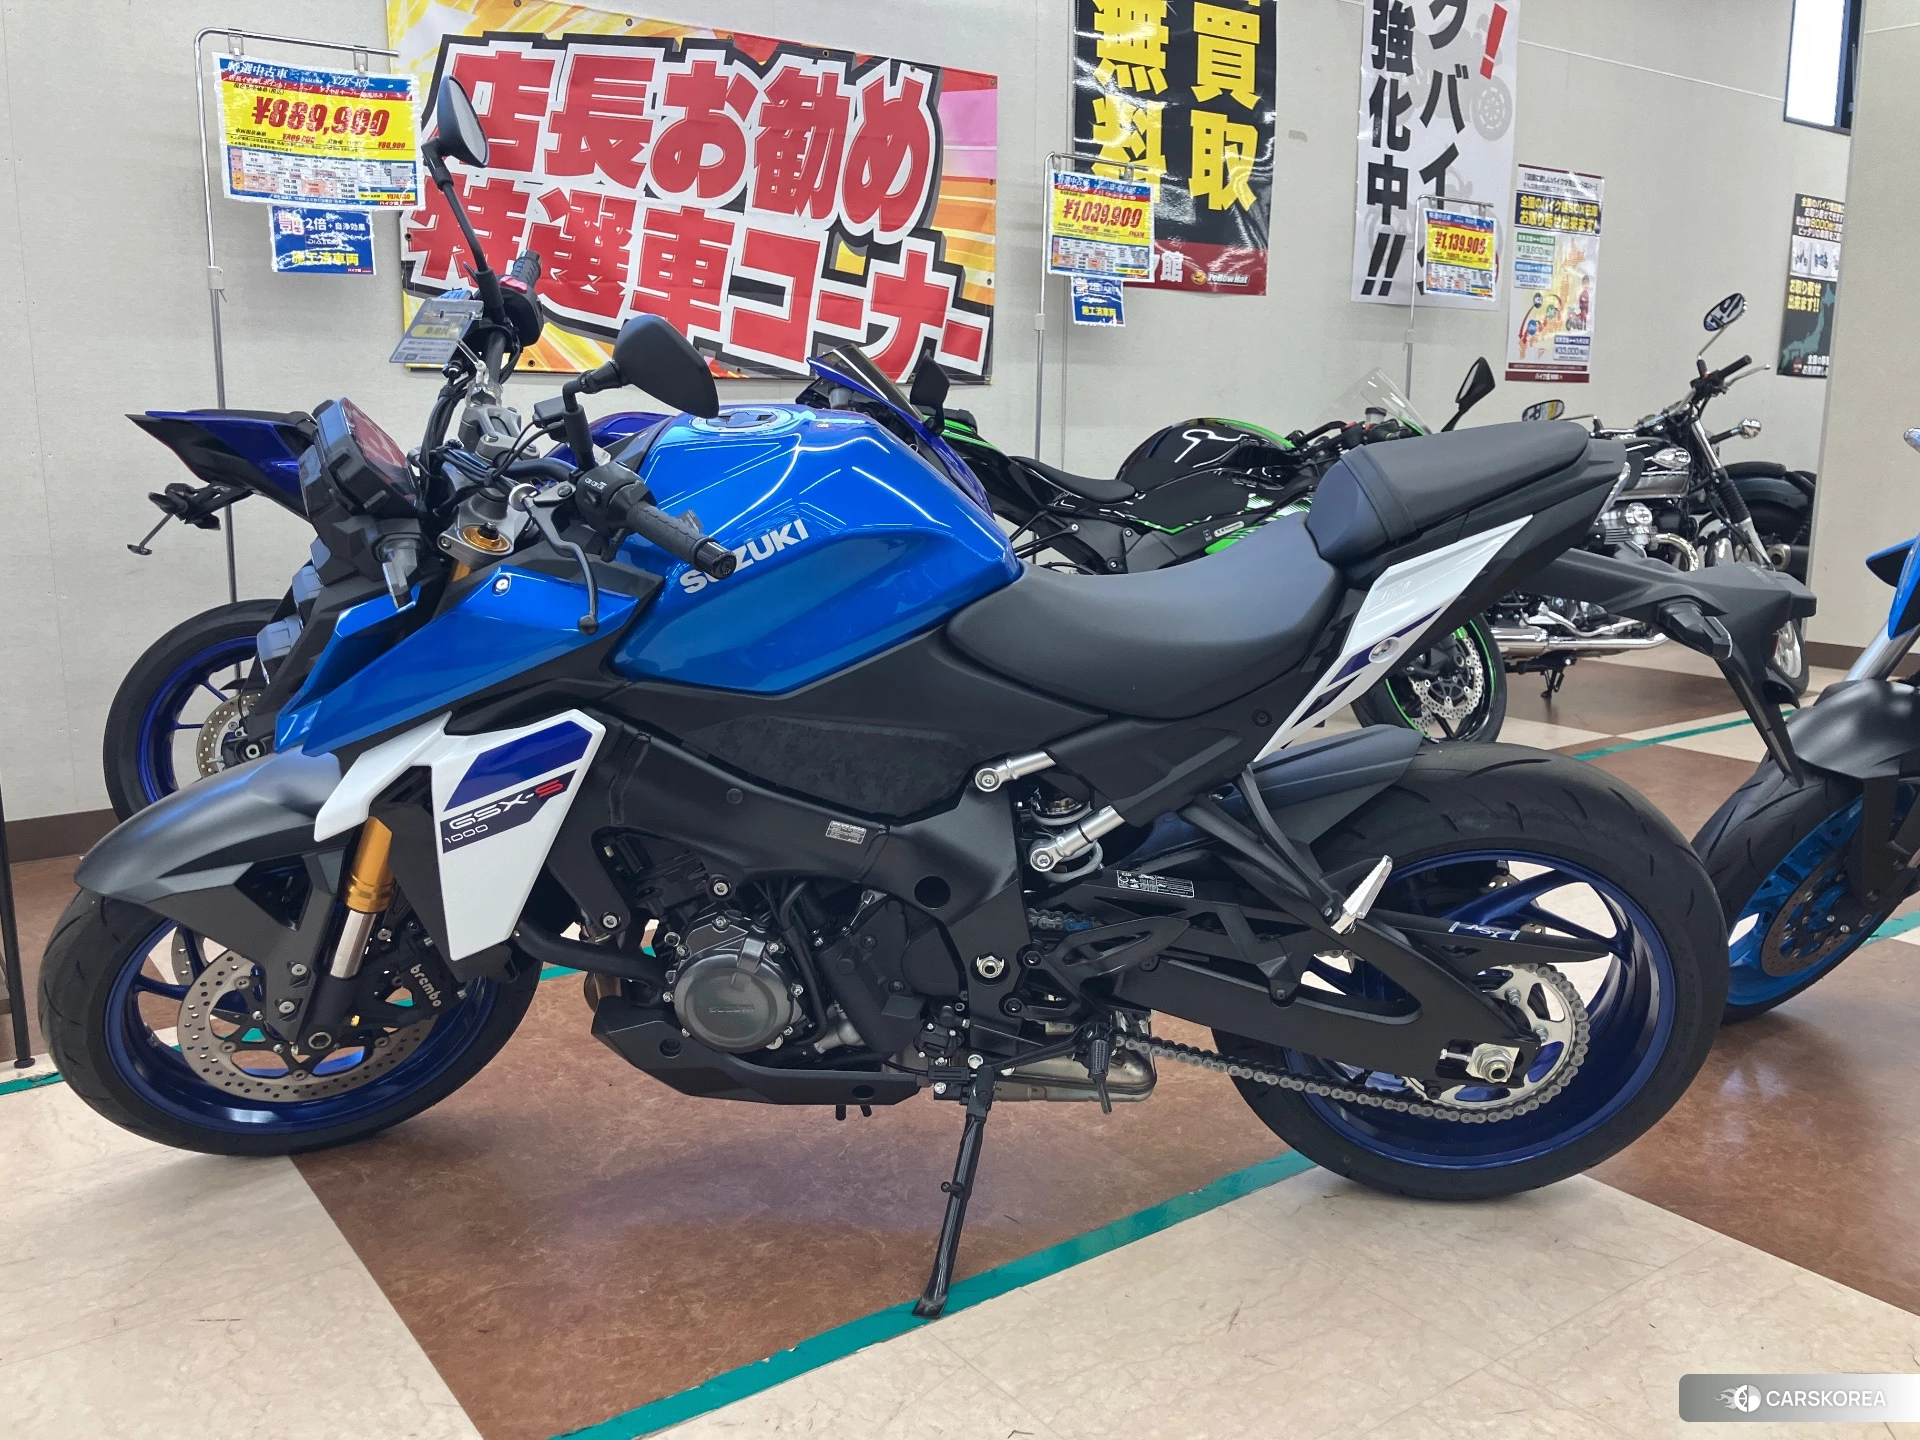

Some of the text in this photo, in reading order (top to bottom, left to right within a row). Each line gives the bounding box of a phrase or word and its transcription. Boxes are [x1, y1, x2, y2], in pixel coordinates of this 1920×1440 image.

[228, 60, 288, 79] 特選中古車
[251, 96, 390, 137] ¥889,900
[1189, 0, 1262, 211] 買取
[440, 48, 934, 236] 店長お勧め
[305, 217, 327, 231] 2倍
[1063, 198, 1143, 228] ¥1,039,900
[404, 174, 985, 383] 特選車コーナー
[679, 518, 809, 594] SZUKI
[449, 779, 564, 830] GSX-S
[444, 824, 489, 844] 1000
[410, 963, 442, 1007] brembo
